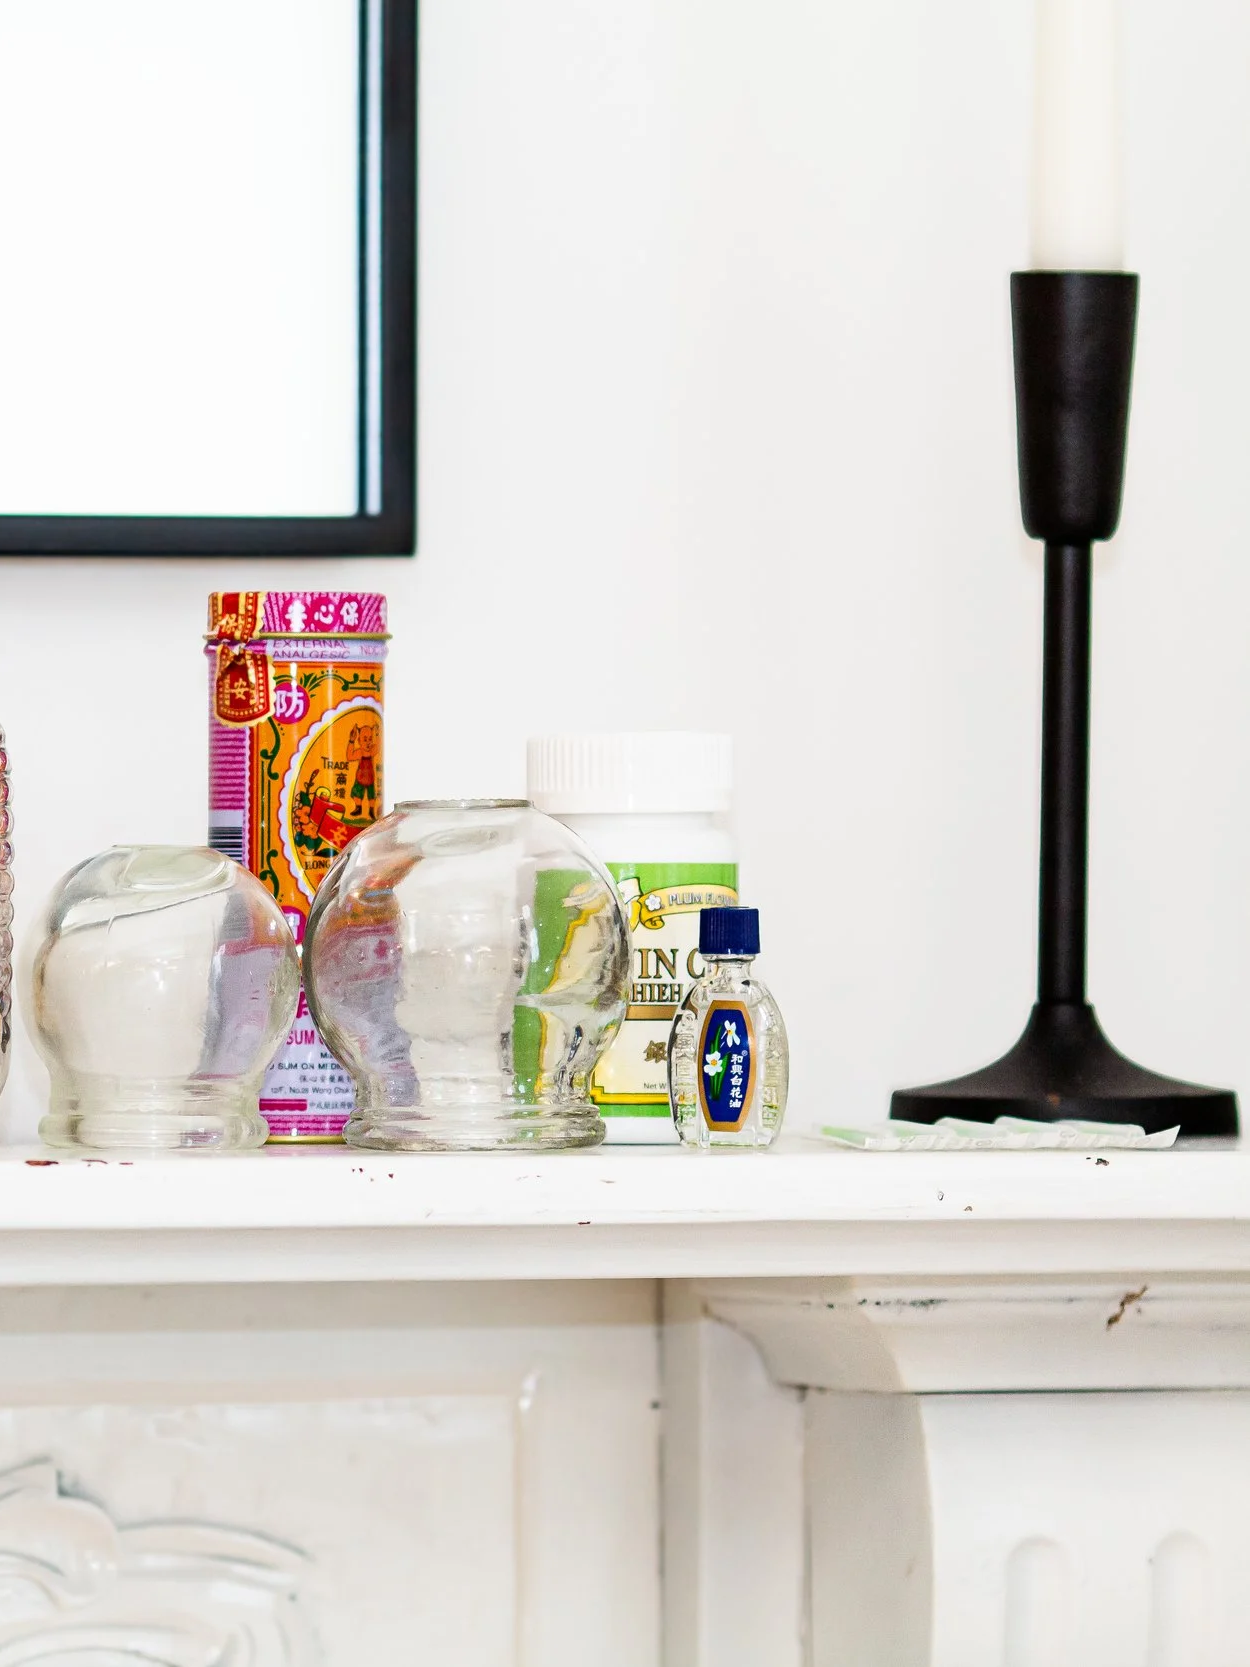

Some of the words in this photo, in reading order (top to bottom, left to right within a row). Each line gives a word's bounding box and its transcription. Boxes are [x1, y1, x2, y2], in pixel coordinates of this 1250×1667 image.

[272, 639, 349, 649] EXTERNAL
[272, 650, 350, 659] ANALGESIC
[275, 687, 305, 718] 防
[321, 756, 350, 770] TRADE
[669, 893, 703, 906] PLUM
[634, 948, 680, 980] IN
[631, 983, 684, 1003] HIEH
[286, 1030, 315, 1045] SUM
[277, 1062, 297, 1070] SUM
[301, 1062, 315, 1070] ON
[729, 1053, 744, 1108] 和興白花油
[312, 1087, 332, 1095] Wong
